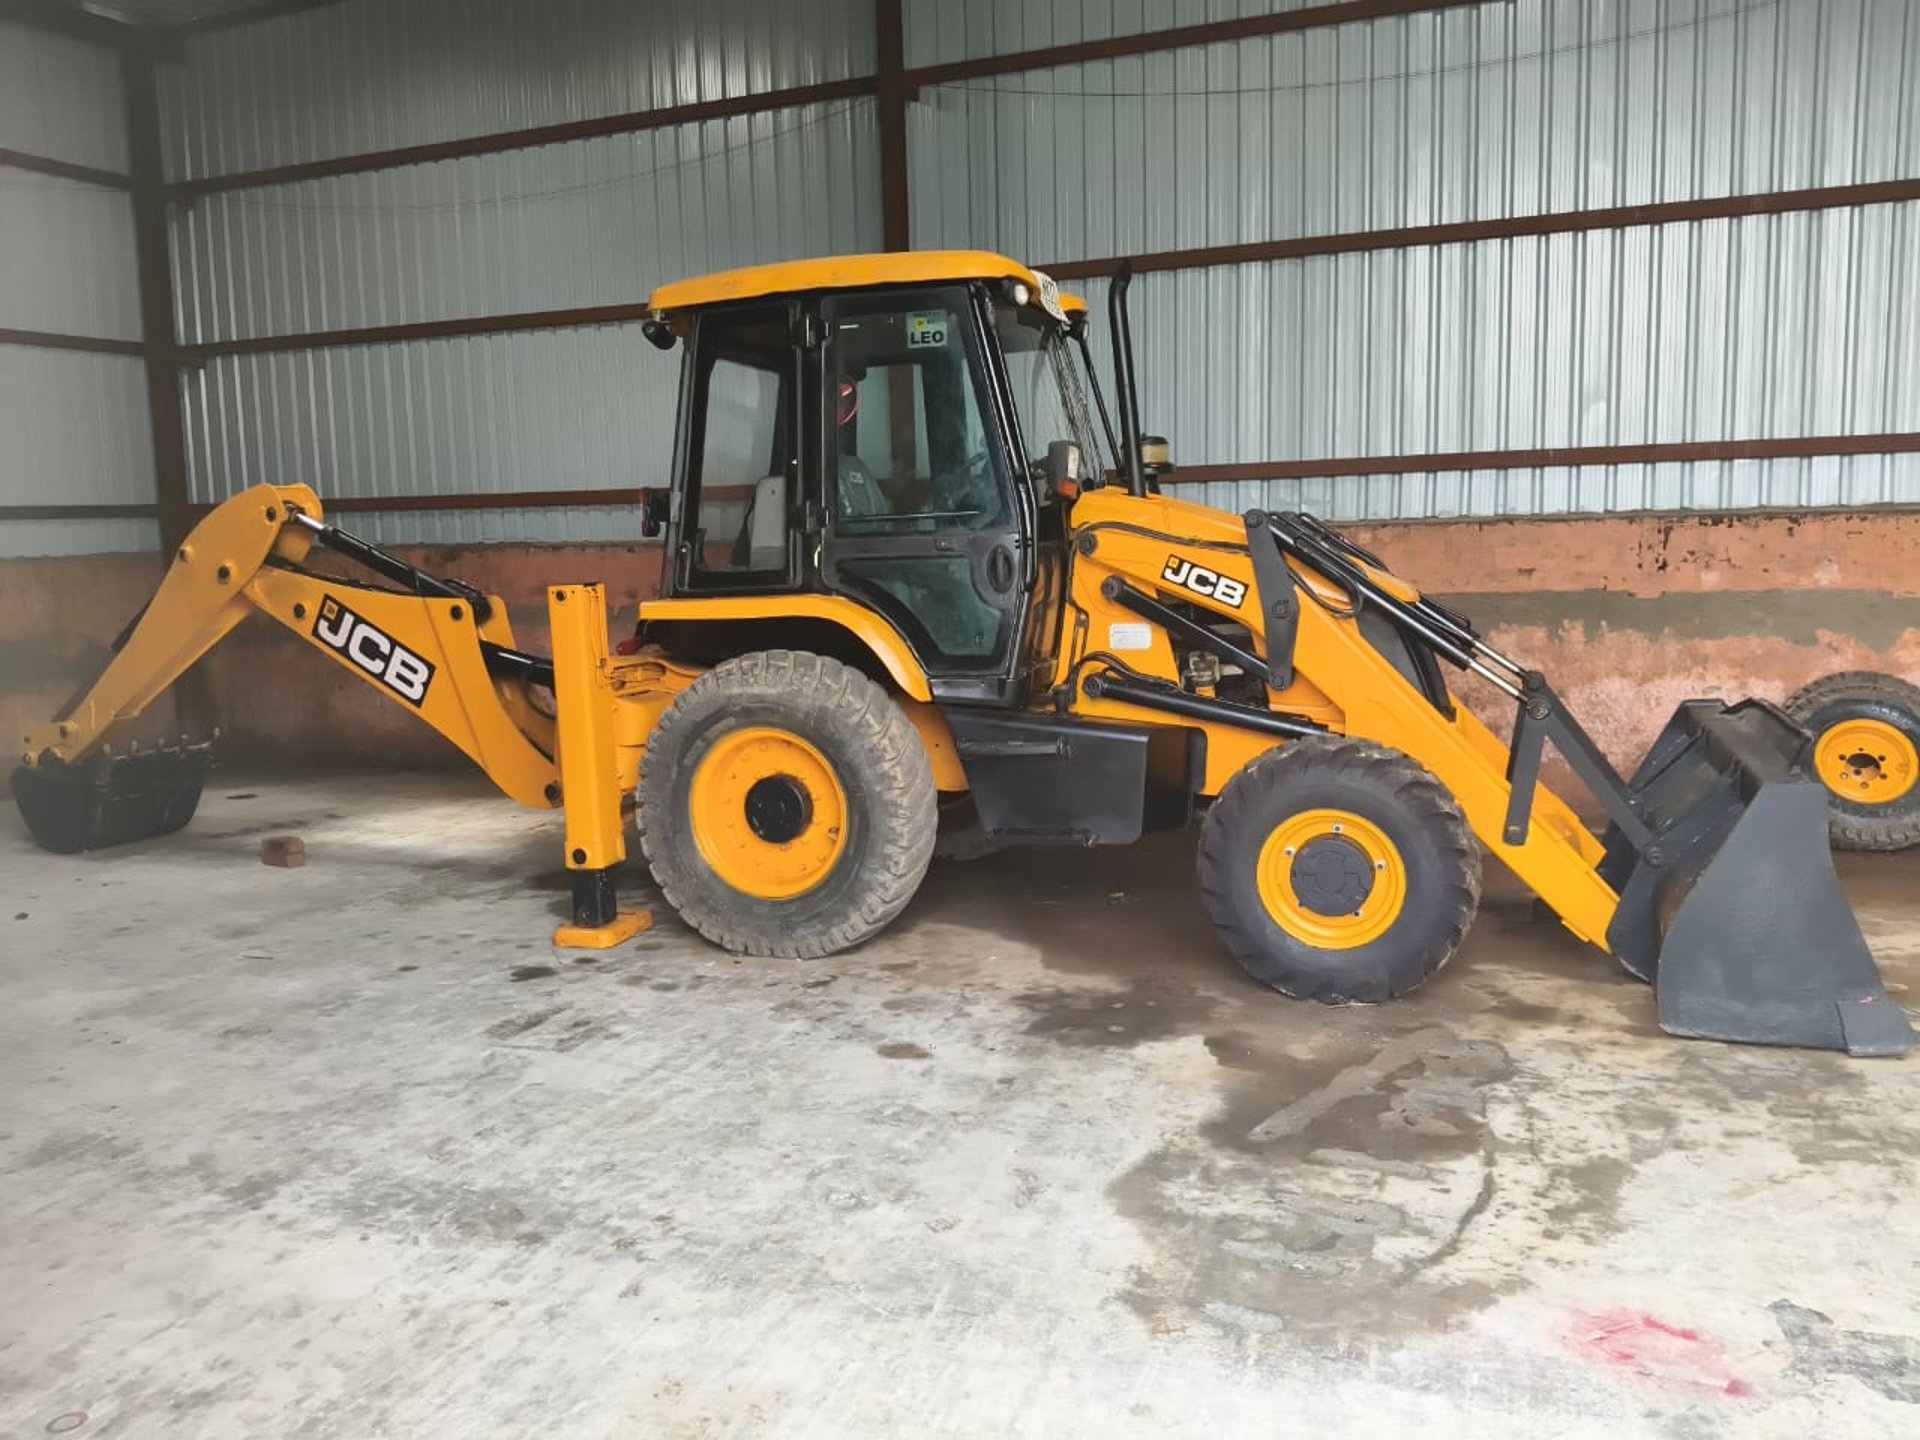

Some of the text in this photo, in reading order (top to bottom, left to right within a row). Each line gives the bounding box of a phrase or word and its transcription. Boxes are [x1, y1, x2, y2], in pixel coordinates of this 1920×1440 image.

[910, 330, 945, 344] LEO
[1163, 561, 1246, 607] JCB
[317, 611, 430, 701] JCB
